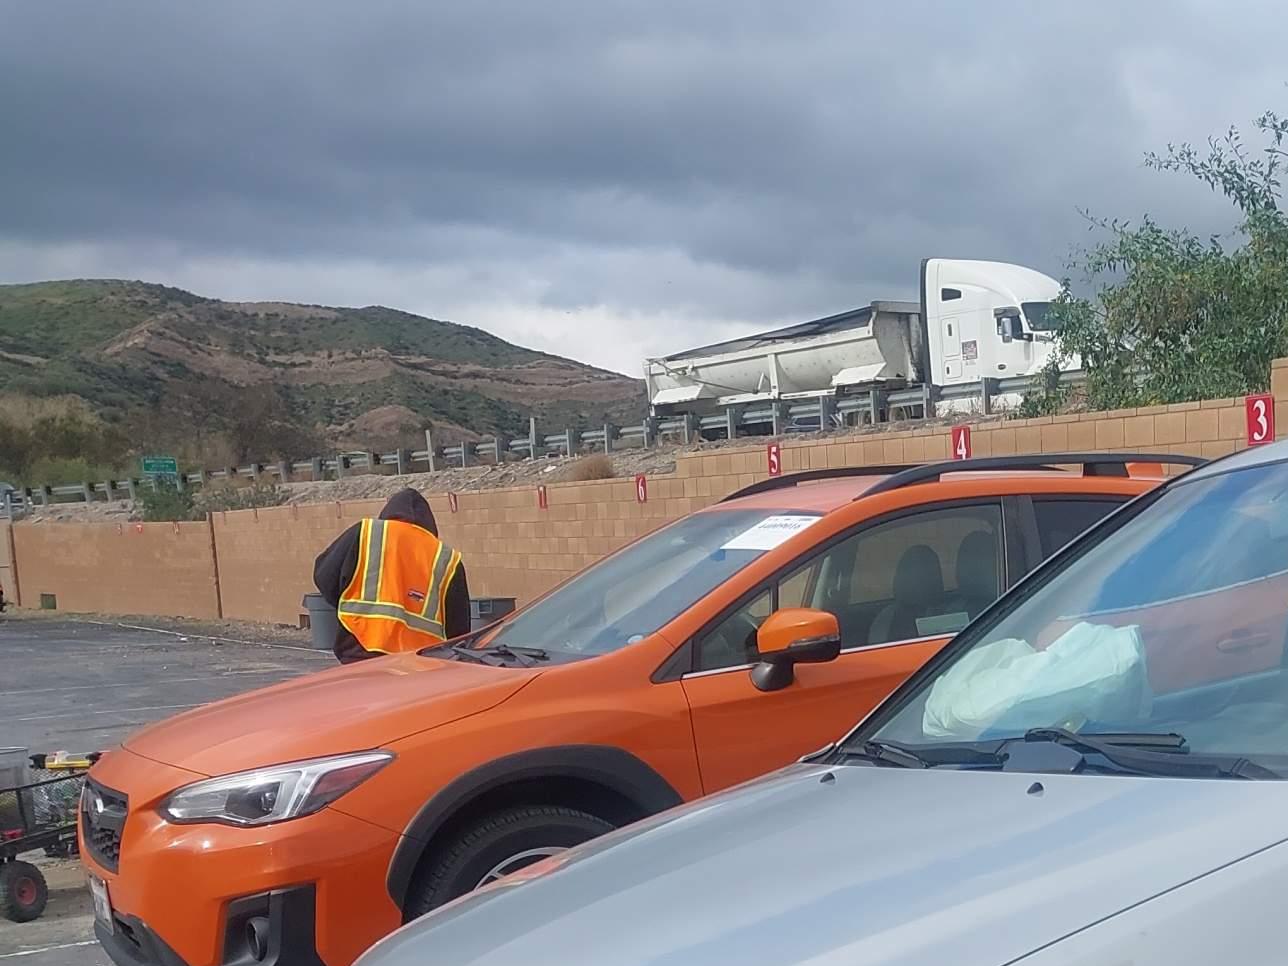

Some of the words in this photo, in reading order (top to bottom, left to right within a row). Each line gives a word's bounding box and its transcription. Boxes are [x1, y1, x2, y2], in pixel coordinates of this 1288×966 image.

[1252, 399, 1268, 441] 3
[770, 446, 778, 473] 5
[956, 429, 967, 460] 4
